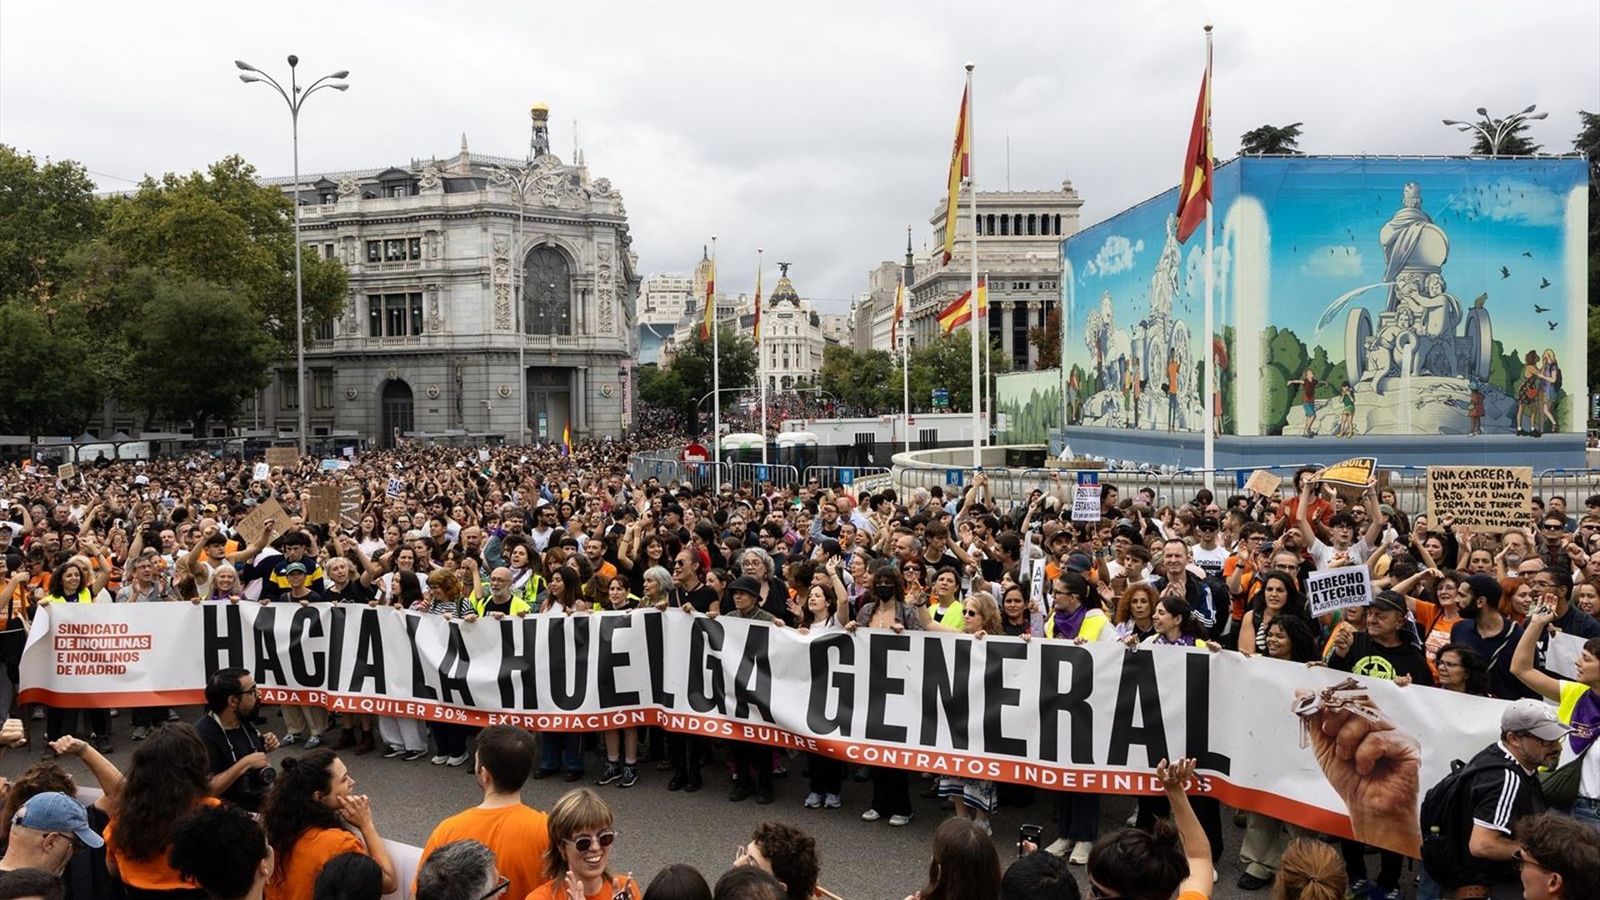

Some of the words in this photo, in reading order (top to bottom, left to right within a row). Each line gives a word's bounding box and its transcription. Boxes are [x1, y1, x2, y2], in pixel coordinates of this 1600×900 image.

[1432, 470, 1456, 480] UNA
[1433, 482, 1448, 491] UN
[1489, 482, 1504, 490] UN
[1435, 501, 1470, 509] FORMA
[1474, 501, 1486, 509] DE
[1489, 501, 1522, 509] TENER
[1486, 518, 1498, 526] MI
[1310, 572, 1364, 592] DERECHO
[1312, 593, 1320, 604] A
[1321, 584, 1366, 602] TECHO
[1319, 600, 1339, 609] JUSTO
[58, 623, 128, 634] SINDICATO
[57, 637, 74, 649] DE
[77, 636, 149, 650] INQUILINAS
[57, 652, 64, 662] E
[66, 652, 139, 663] INQUILINOS
[57, 665, 72, 675] DE
[75, 664, 126, 675] MADRID
[203, 605, 386, 696] HACIA
[406, 614, 476, 706] LA
[498, 612, 776, 724] HUELGA
[806, 633, 1231, 778] GENERAL
[256, 689, 301, 702] ADA
[333, 697, 426, 716] ALQUILER
[433, 706, 467, 721] 50%
[488, 710, 645, 729] EXPROPIACIÓN
[657, 711, 734, 735] FONDOS
[744, 726, 818, 751] BUITRE
[845, 745, 1001, 777] CONTRATOS
